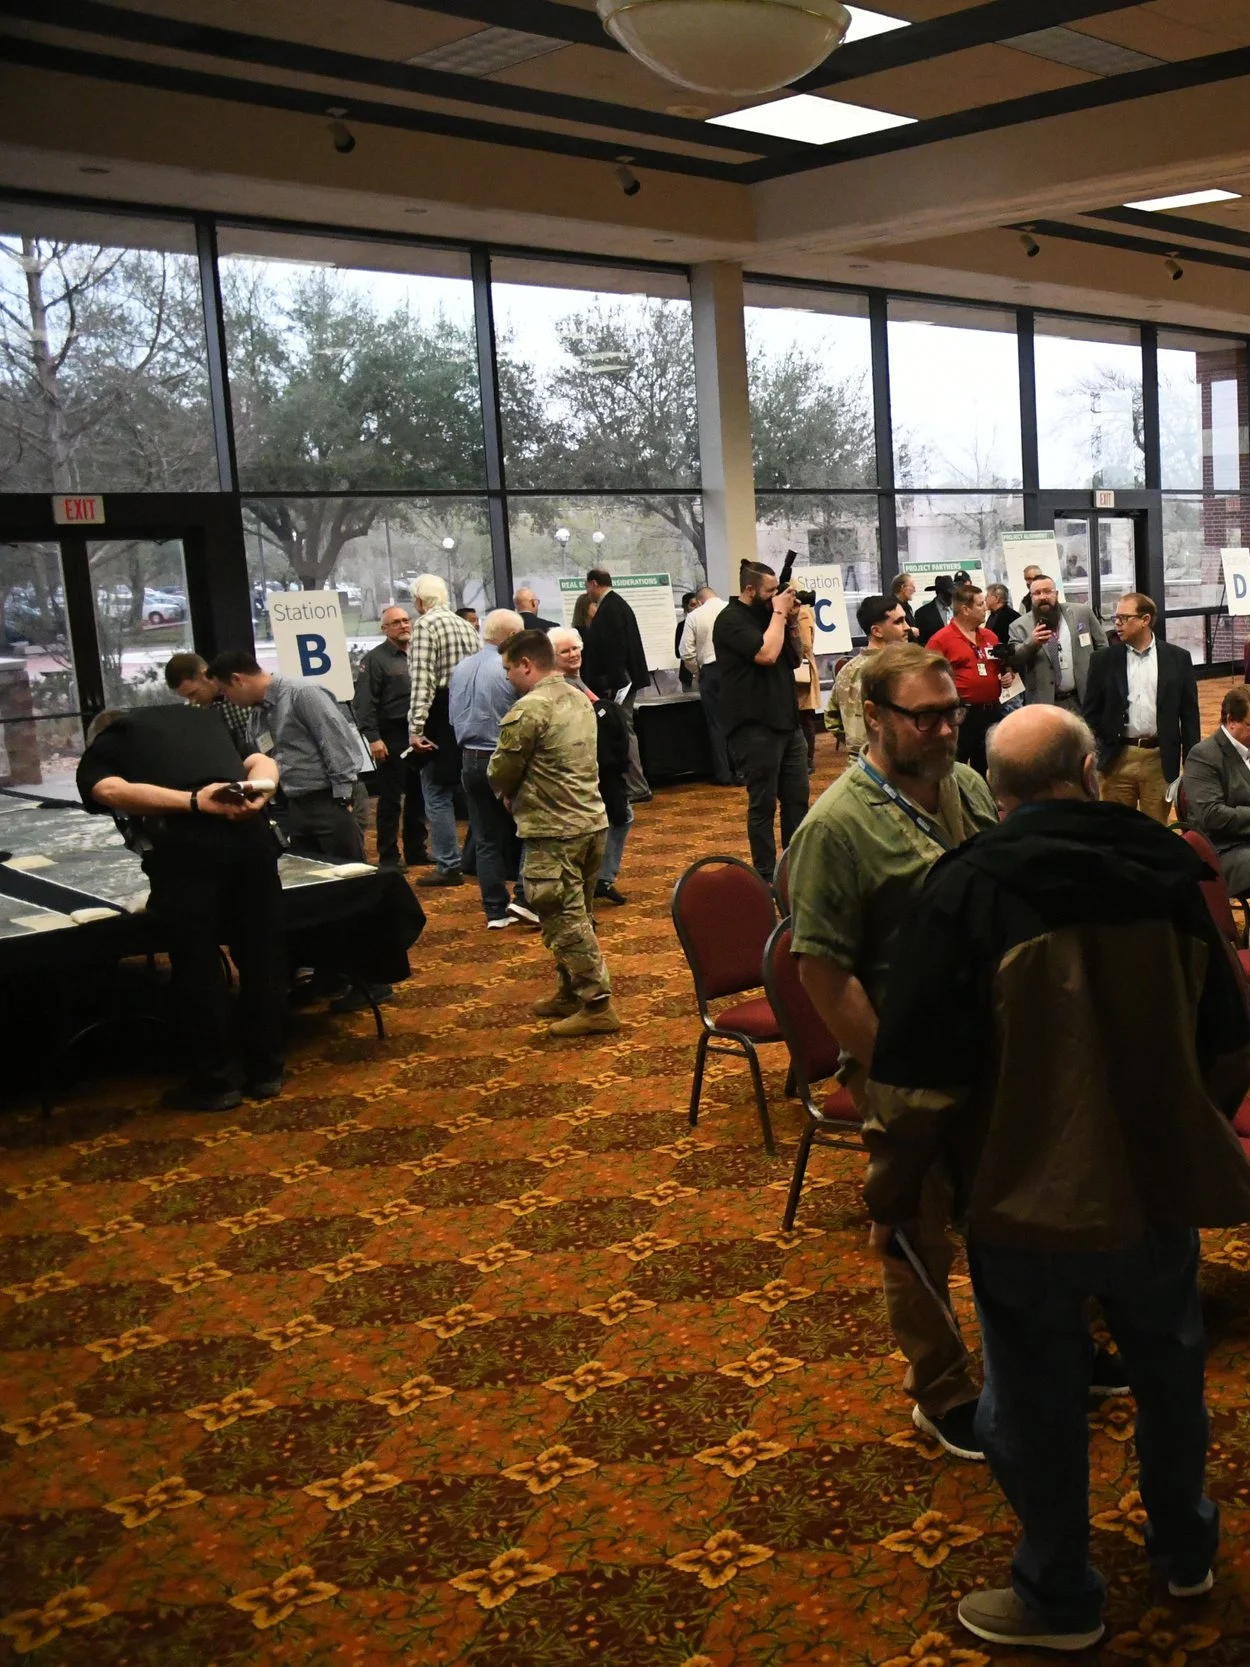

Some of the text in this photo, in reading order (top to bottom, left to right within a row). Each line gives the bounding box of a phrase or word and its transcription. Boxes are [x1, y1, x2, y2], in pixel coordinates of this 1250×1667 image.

[64, 498, 96, 520] EXIT
[1100, 492, 1112, 506] EXIT
[905, 563, 962, 572] PROJECT PARTNERS
[561, 581, 578, 590] REAL
[612, 578, 658, 587] NSIDERATIONS
[797, 574, 840, 590] Station
[1233, 574, 1247, 599] D
[273, 602, 338, 622] Station
[814, 598, 836, 633] C
[296, 633, 332, 677] B
